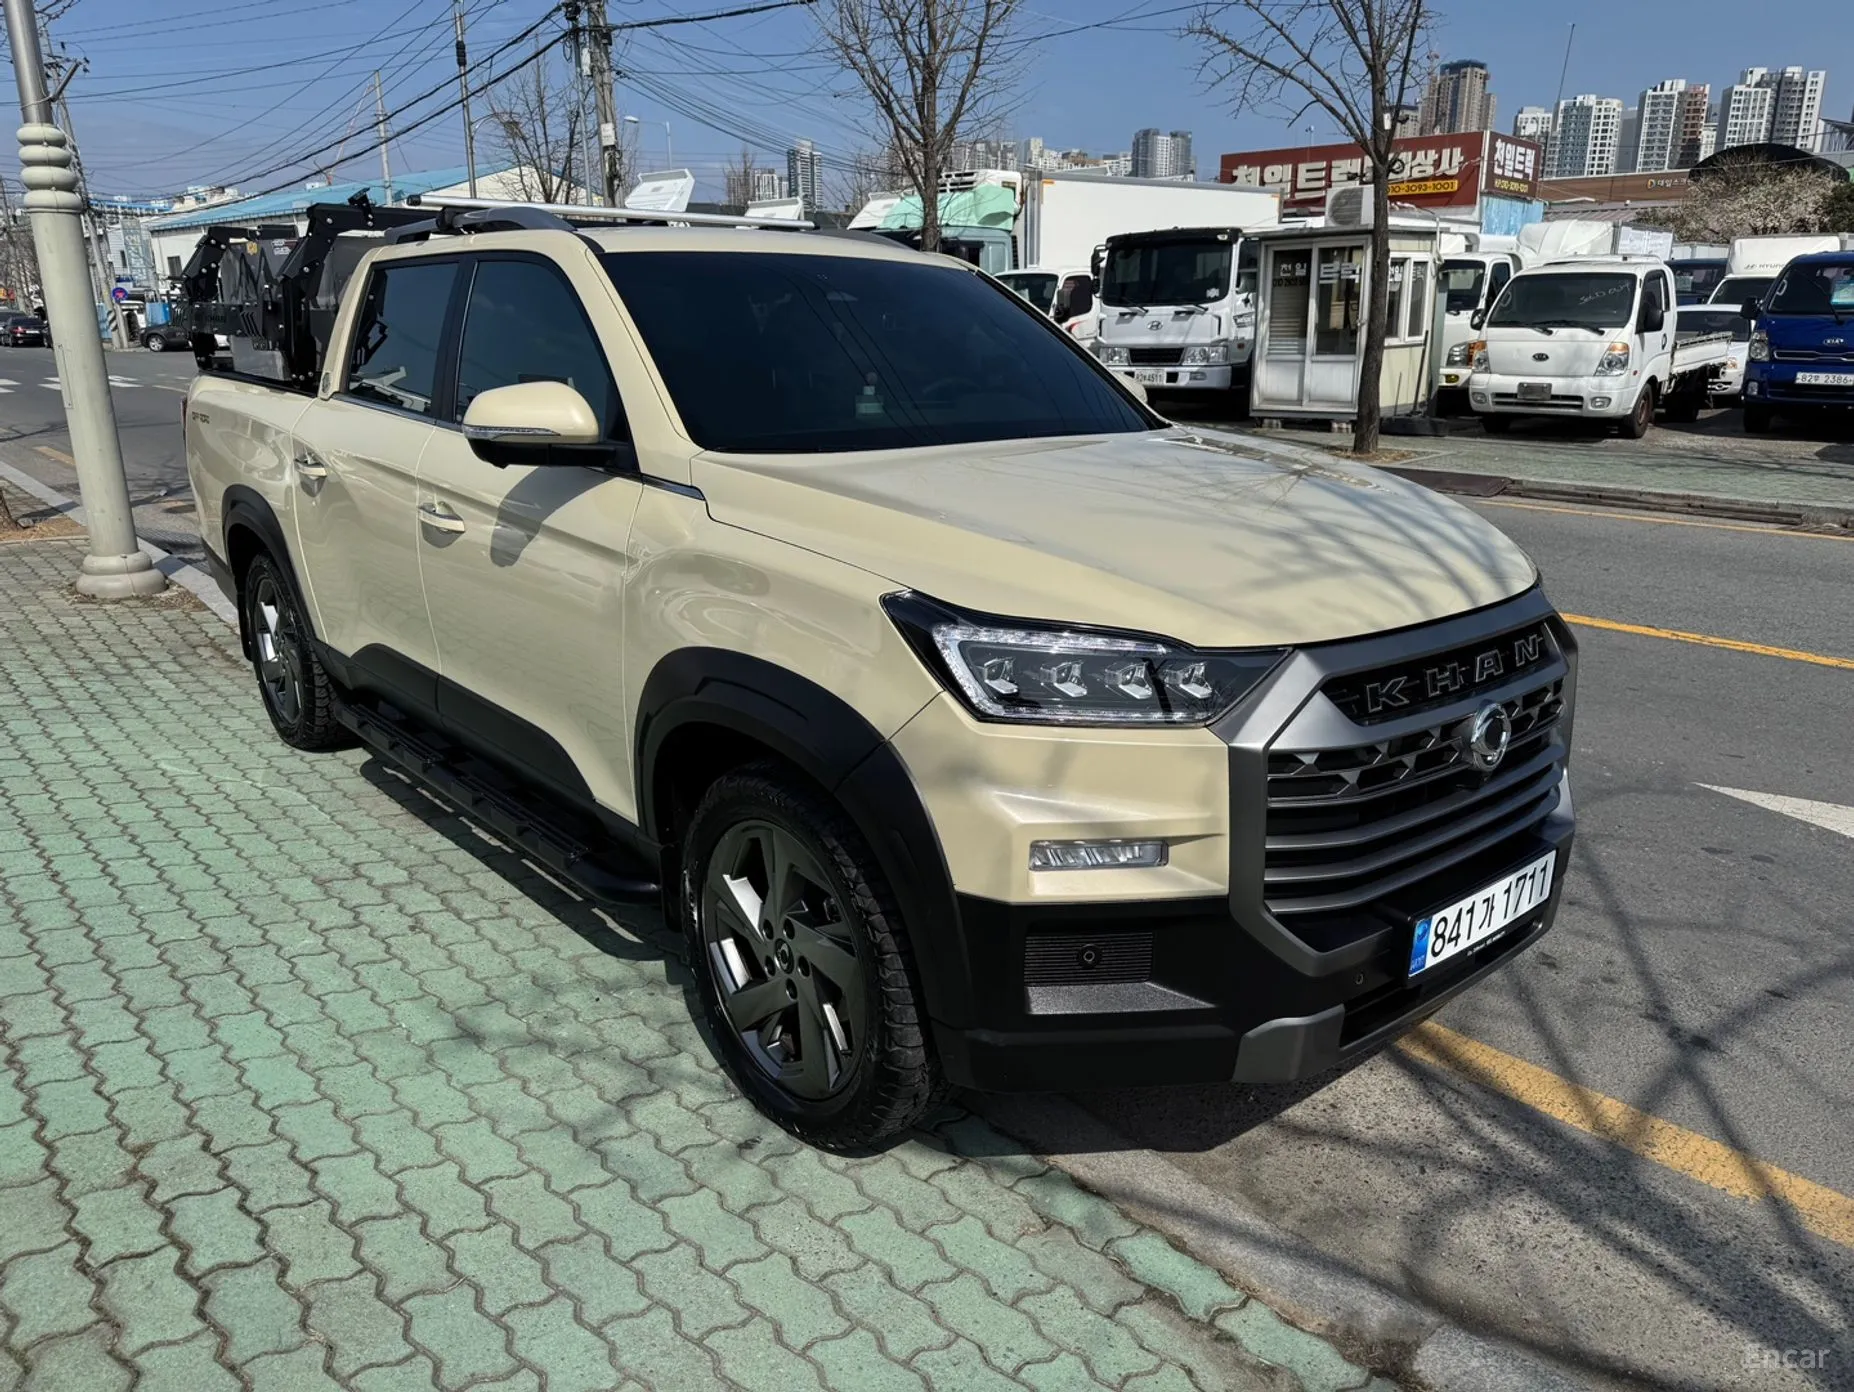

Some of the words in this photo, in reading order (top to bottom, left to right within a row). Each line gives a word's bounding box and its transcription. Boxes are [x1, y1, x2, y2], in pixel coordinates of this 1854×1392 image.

[1494, 138, 1536, 181] 천일트럭
[1319, 261, 1361, 284] 트럭
[1366, 633, 1541, 714] KHAN
